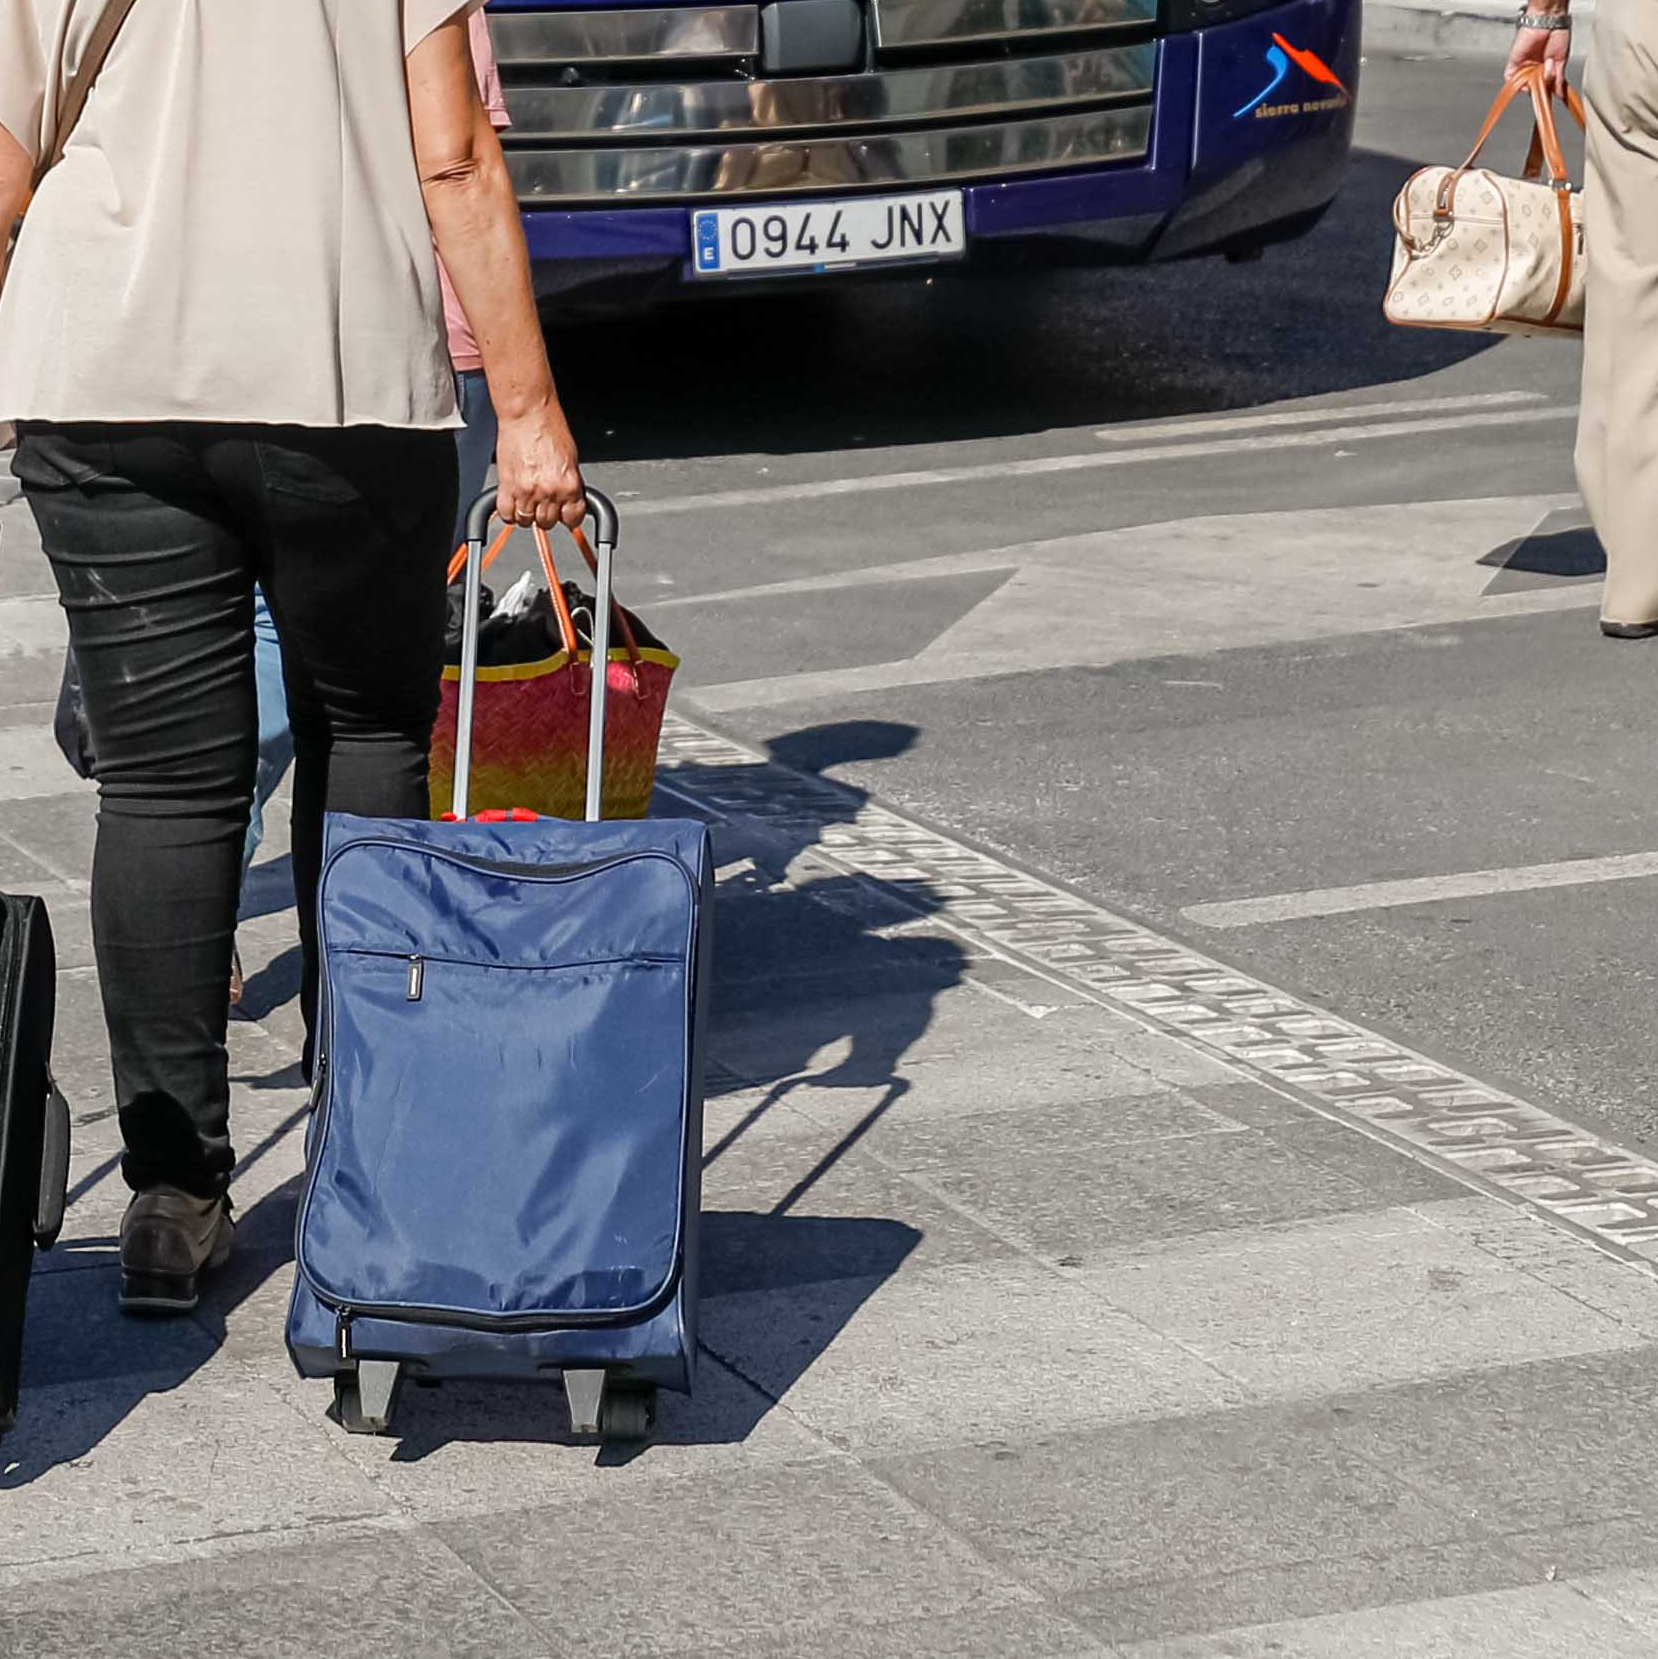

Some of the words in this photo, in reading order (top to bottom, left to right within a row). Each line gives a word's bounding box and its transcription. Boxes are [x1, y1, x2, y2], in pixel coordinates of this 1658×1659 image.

[1255, 103, 1299, 118] sierra
[703, 247, 714, 261] E
[731, 209, 850, 260] 0944
[871, 200, 952, 249] JNX
